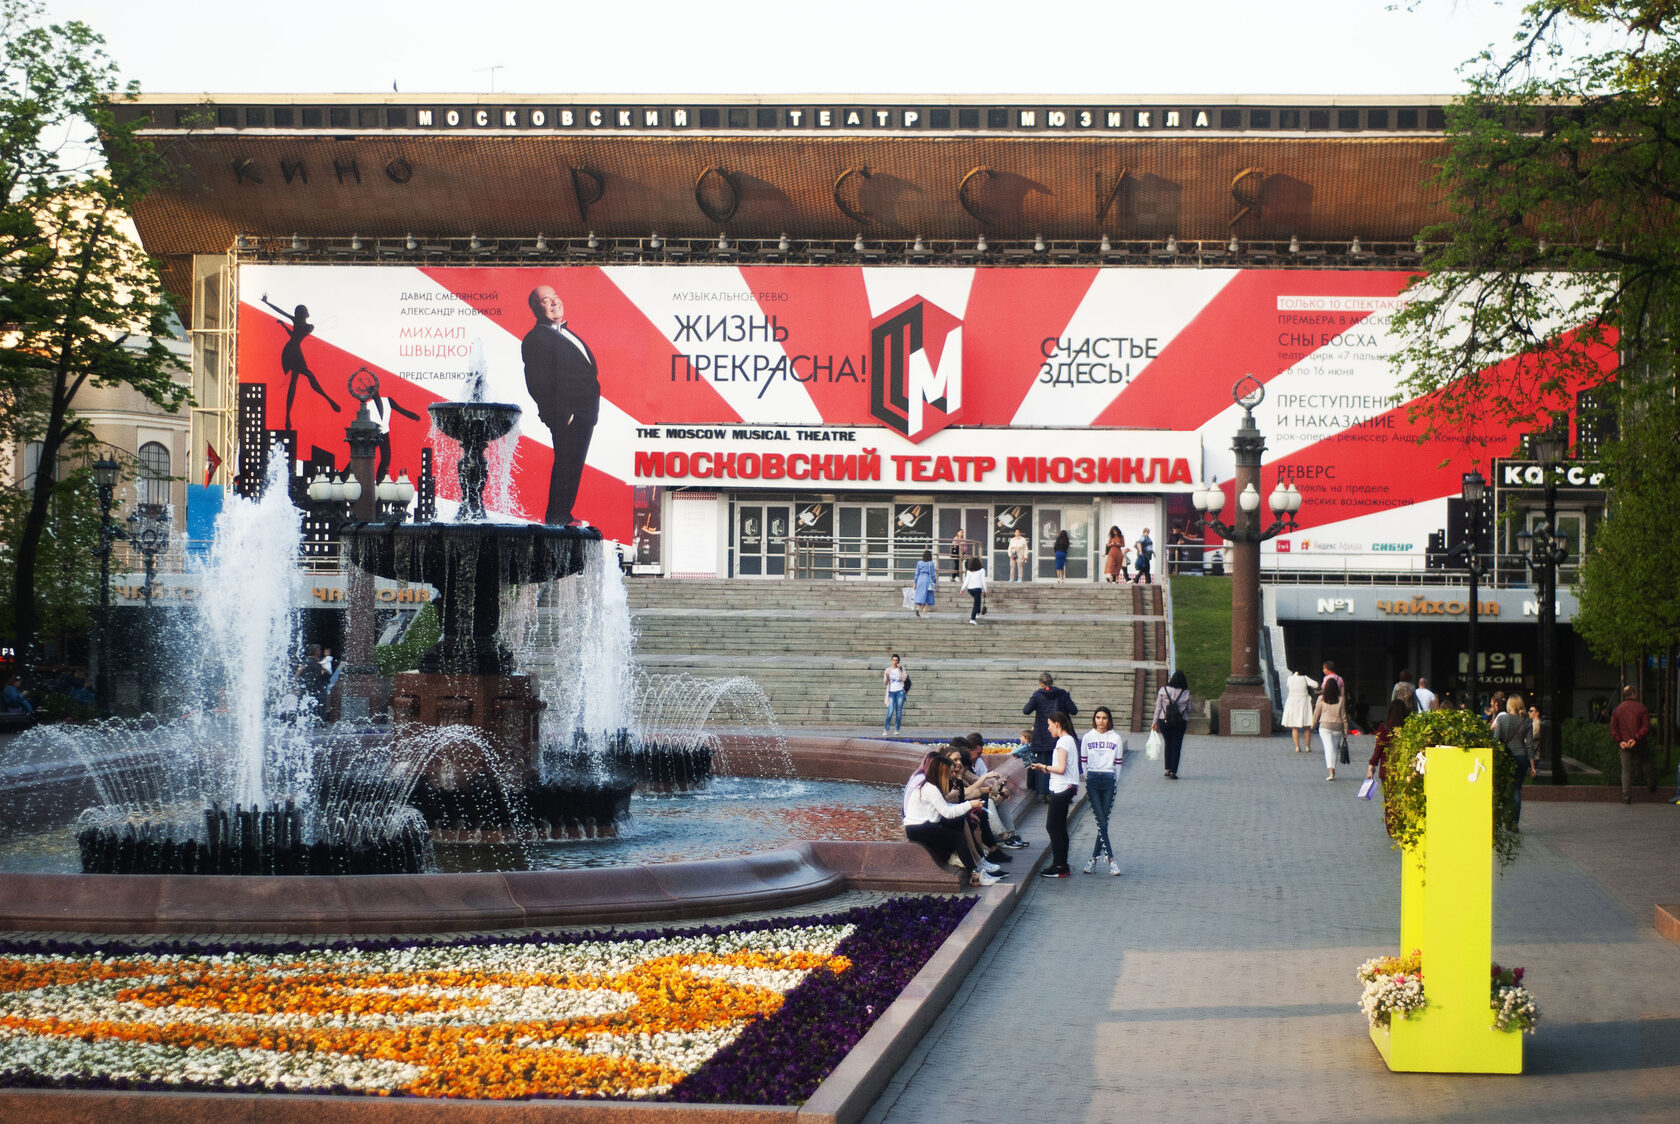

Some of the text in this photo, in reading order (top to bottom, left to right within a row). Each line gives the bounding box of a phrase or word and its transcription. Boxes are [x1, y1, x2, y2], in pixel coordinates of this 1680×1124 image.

[419, 110, 1208, 127] МОСКОВСКИЙ ТЕАТР МЮЗИКЛА
[231, 156, 413, 185] КИНО
[400, 291, 499, 301] ДАВИД СМЕЛЯНСКИЙ
[672, 292, 789, 302] МУЗЫКАЛЬНОЕ РЕВЮ
[1279, 298, 1326, 309] ТОЛЬКО
[1329, 299, 1341, 309] 10
[400, 308, 502, 316] АЛЕКСАНДР НОВИКОВ
[1278, 314, 1394, 327] ПРЕМЬЕРА В МОСКВ
[399, 326, 466, 339] МИХАИЛ
[673, 314, 789, 343] ЖИЗНЬ
[1278, 332, 1378, 348] СНЫ БОСХА
[1040, 337, 1159, 362] СЧАСТЬЕ
[671, 354, 867, 399] ПРЕКРАСНА!
[1039, 362, 1131, 388] ЗДЕСЬ!
[1314, 366, 1325, 376] 16
[1328, 368, 1354, 377] июня
[1277, 414, 1396, 429] И НАКАЗАНИЕ
[636, 428, 857, 442] THE MOSCOW MUSICAL THEATRE
[1337, 434, 1388, 443] режиссер
[634, 447, 1193, 484] МОСКОВСКИЙ ТЕАТР МЮЗИКЛА
[1277, 465, 1336, 479] РЕВЕРС
[1330, 485, 1343, 493] на
[1346, 484, 1390, 494] пределе
[1340, 498, 1415, 507] возможностей
[1371, 542, 1414, 552] СИБУР
[1316, 597, 1355, 615] №1
